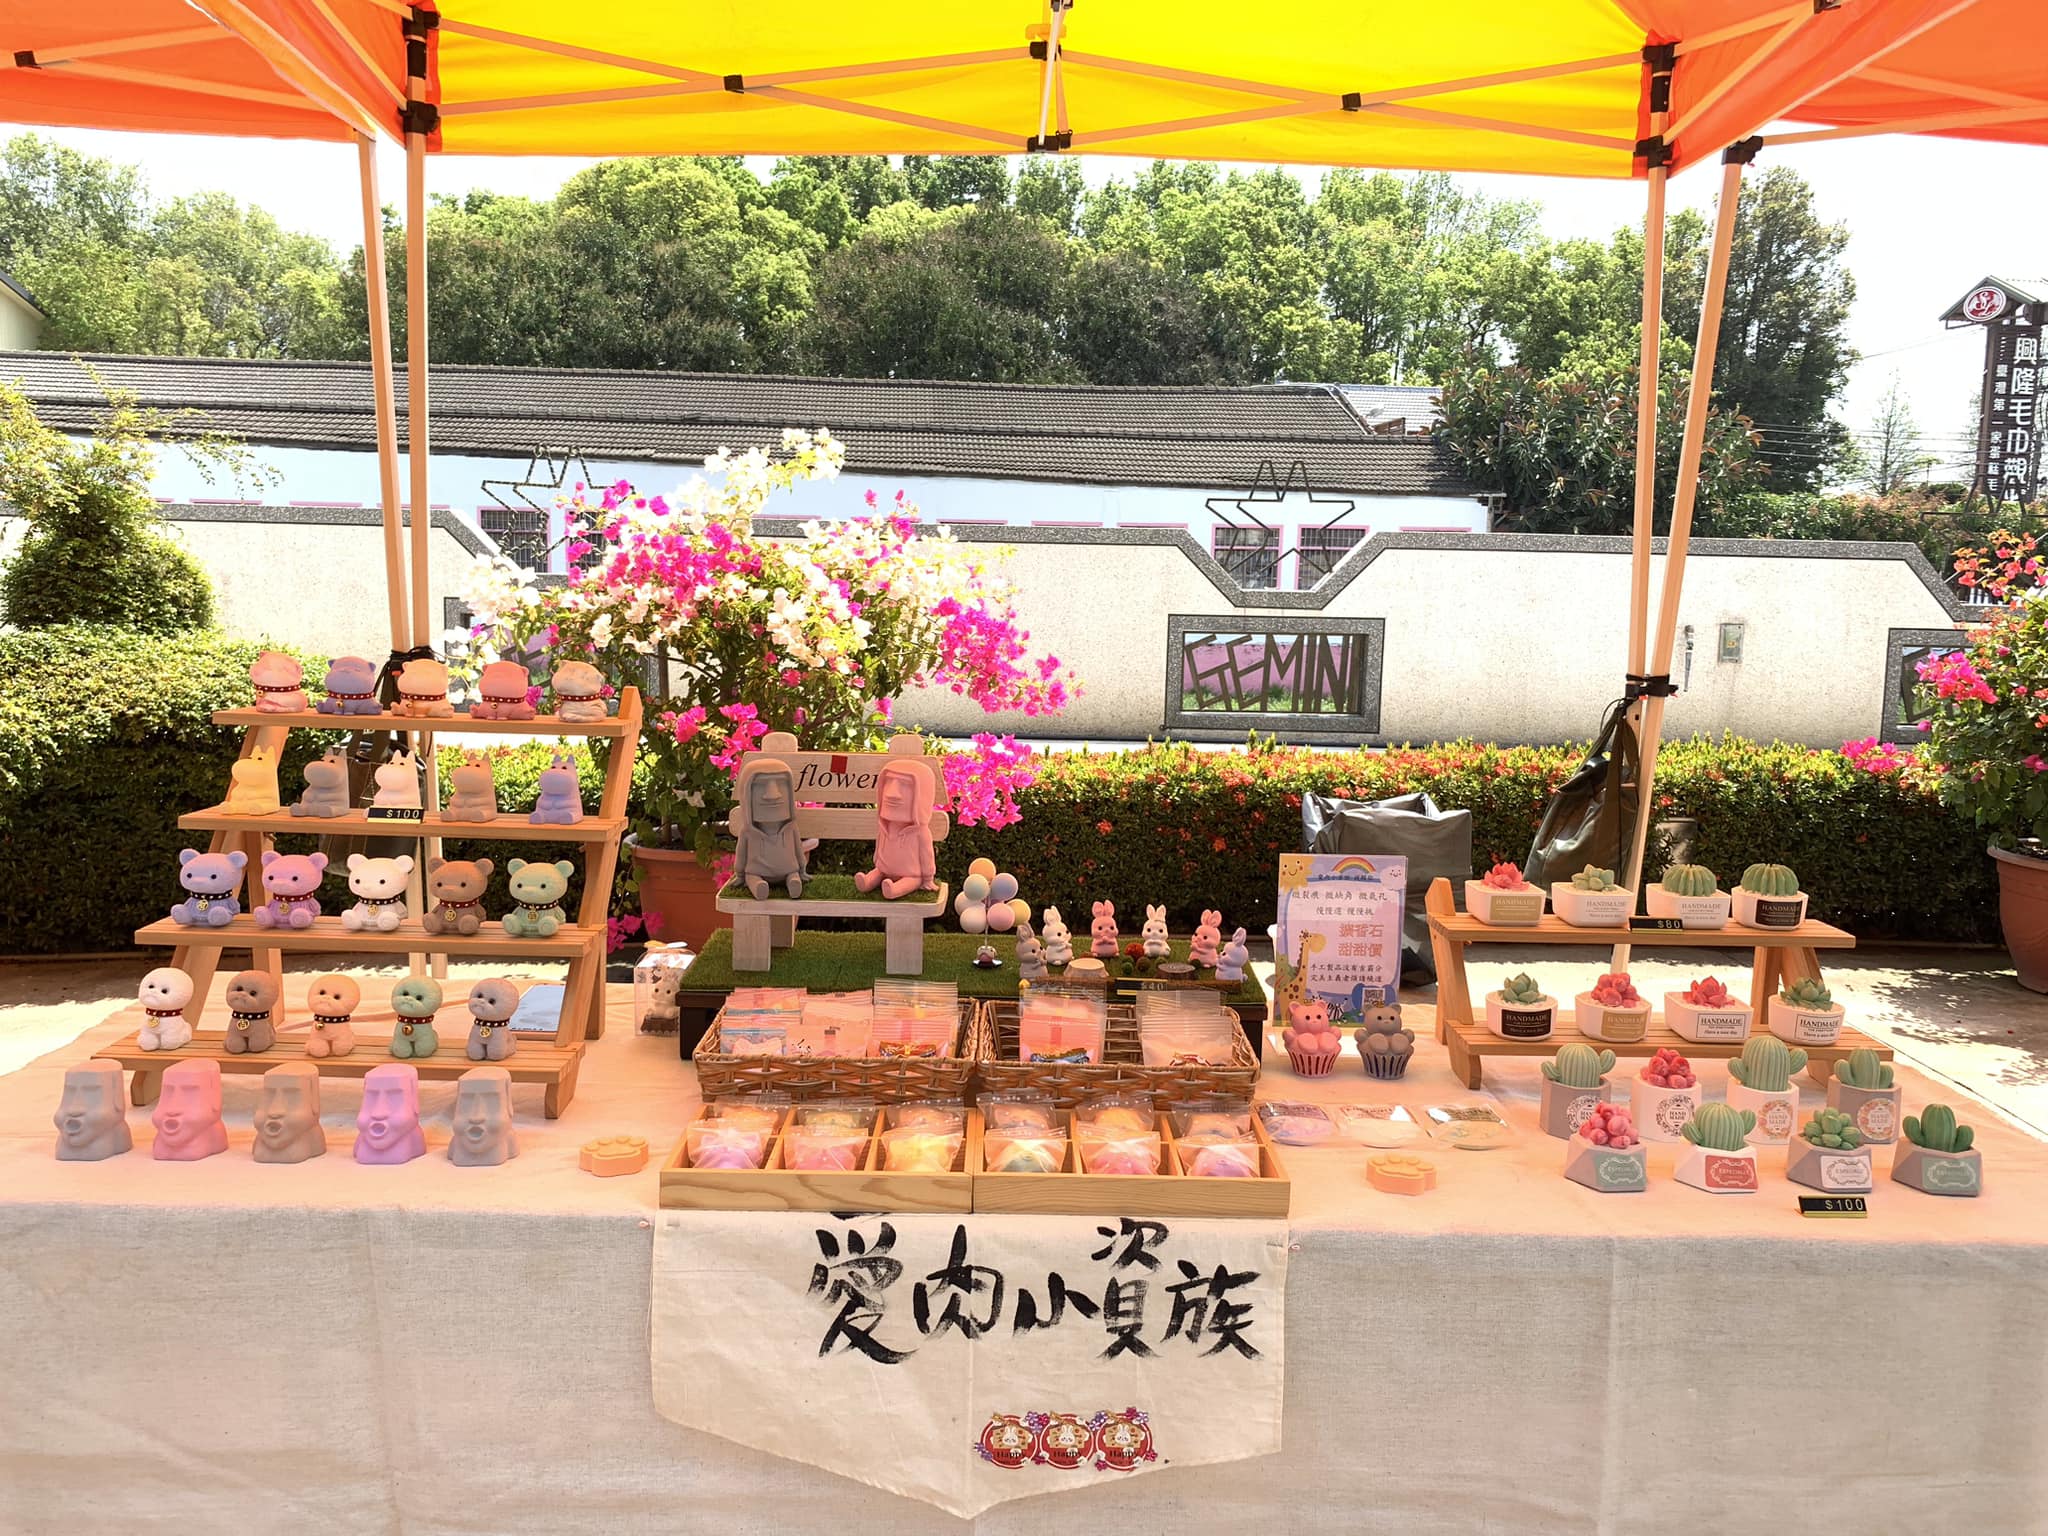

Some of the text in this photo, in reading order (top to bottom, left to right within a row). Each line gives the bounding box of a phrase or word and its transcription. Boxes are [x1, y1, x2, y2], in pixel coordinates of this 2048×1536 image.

[386, 809, 420, 819] $100
[1657, 919, 1681, 929] $80
[1824, 1199, 1864, 1210] $100
